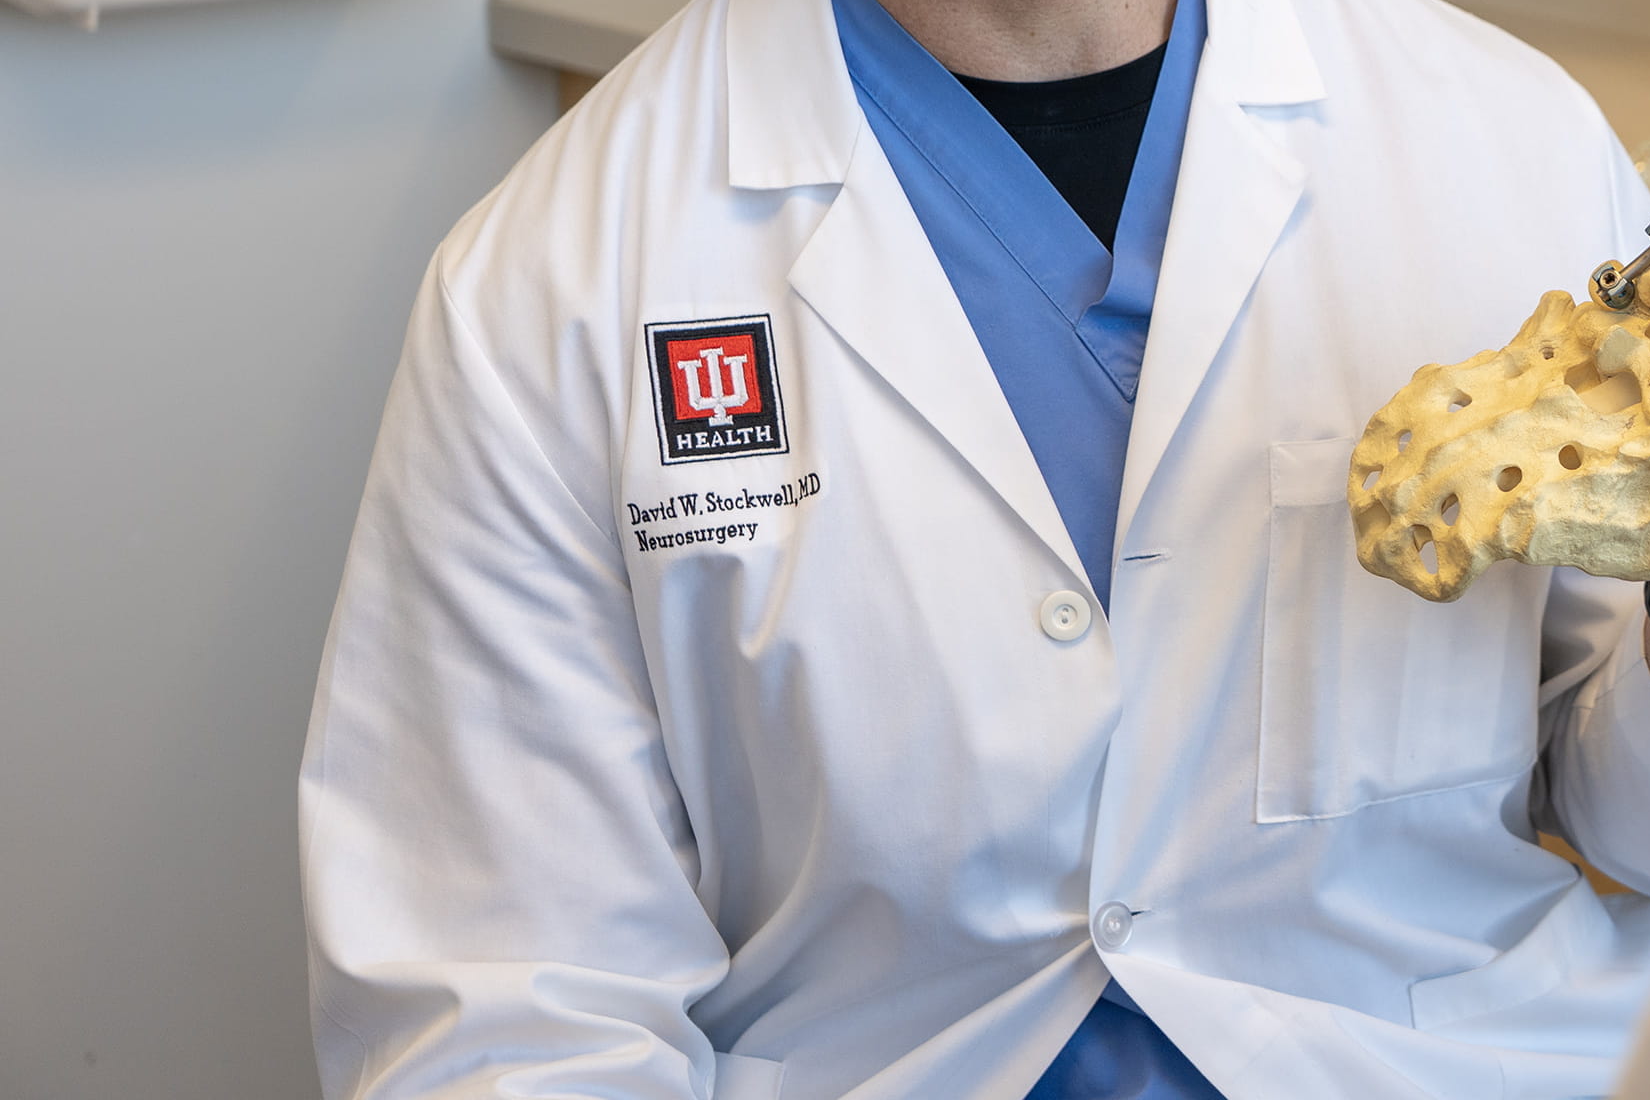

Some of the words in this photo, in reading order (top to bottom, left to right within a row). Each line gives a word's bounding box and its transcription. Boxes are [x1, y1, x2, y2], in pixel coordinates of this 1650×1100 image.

[676, 424, 774, 450] HEALTH
[627, 497, 678, 525] David
[677, 493, 703, 517] W.
[634, 523, 759, 552] Neurosurgery
